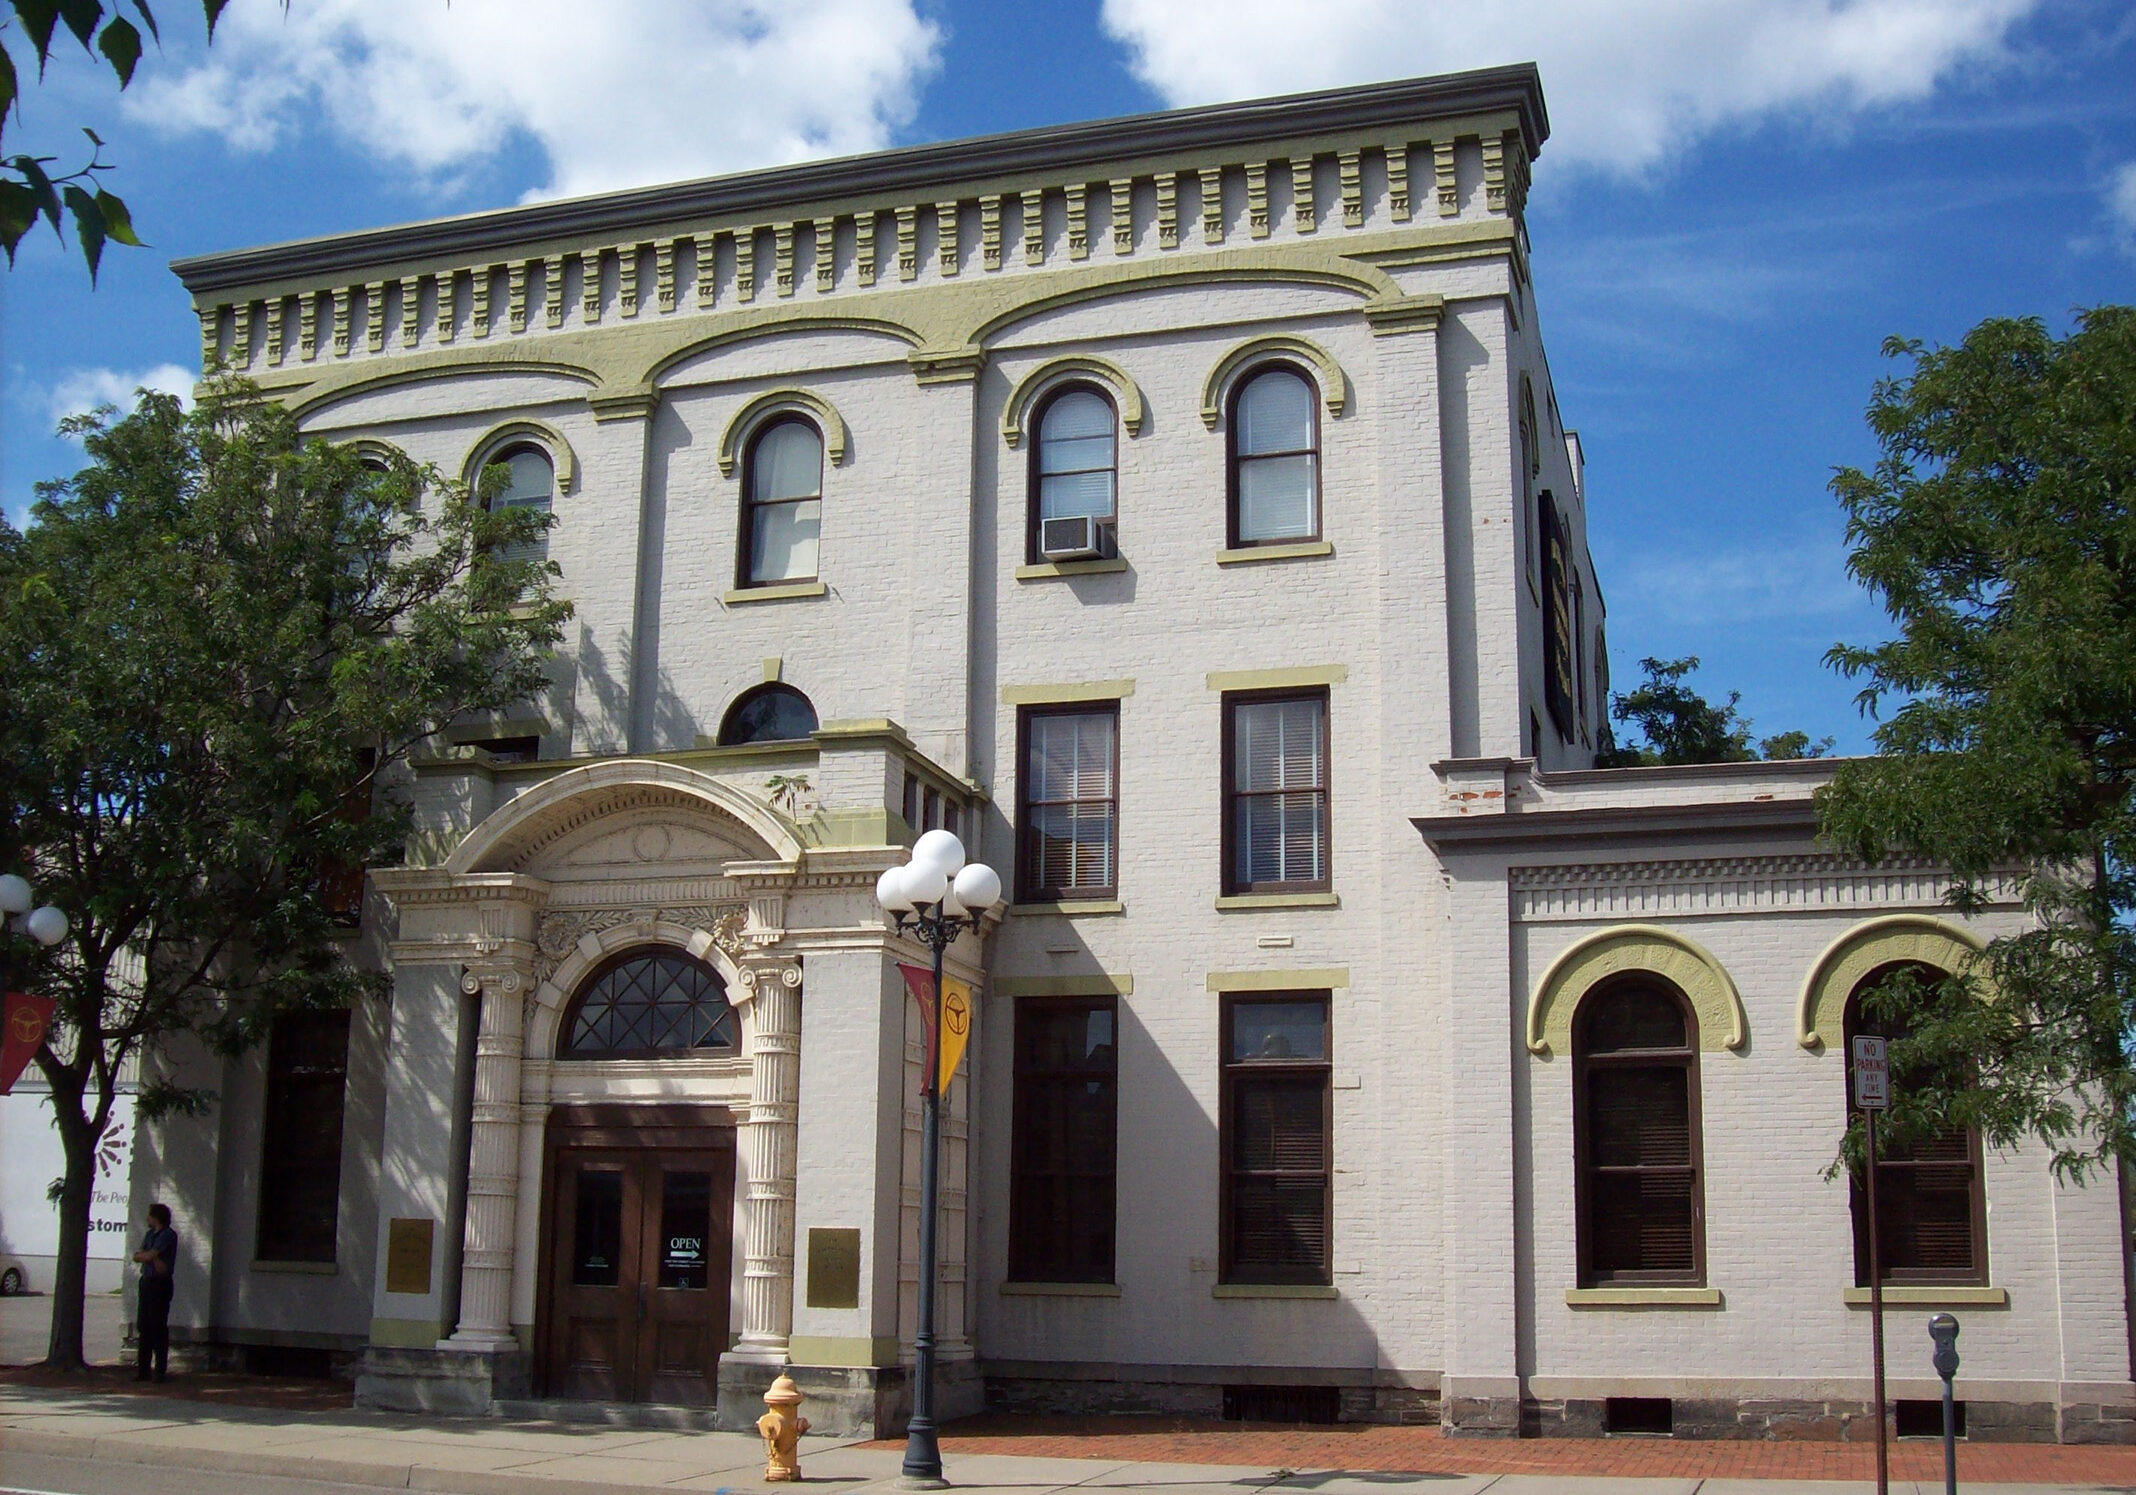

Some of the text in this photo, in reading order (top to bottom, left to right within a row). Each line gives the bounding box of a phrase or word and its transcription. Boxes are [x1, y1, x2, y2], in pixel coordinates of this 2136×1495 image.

[1863, 1043, 1876, 1056] NO
[1857, 1058, 1886, 1072] PARKING
[1865, 1073, 1878, 1082] ANY
[1864, 1083, 1880, 1094] TIME
[91, 1190, 109, 1204] The
[670, 1237, 701, 1249] OPEN
